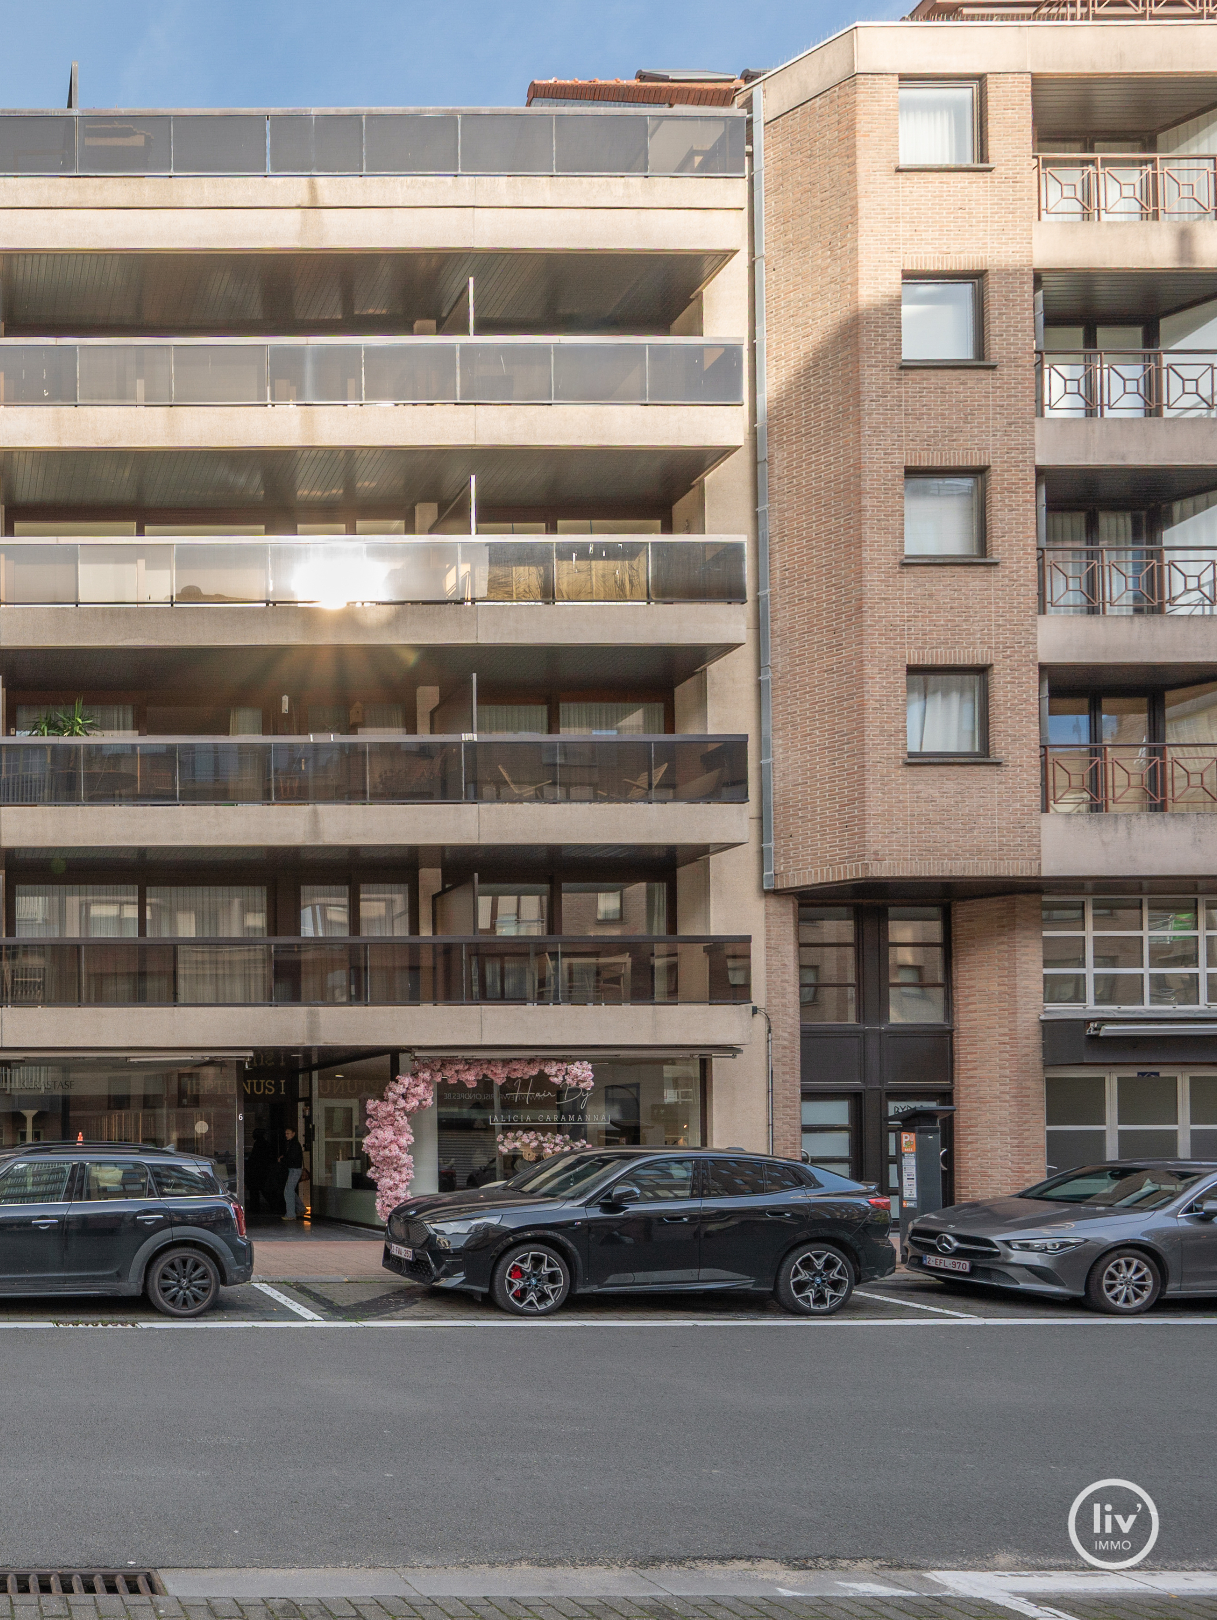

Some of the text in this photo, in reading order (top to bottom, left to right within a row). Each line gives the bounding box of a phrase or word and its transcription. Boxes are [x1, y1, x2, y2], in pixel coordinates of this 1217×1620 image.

[506, 1079, 556, 1105] Hair
[238, 1113, 244, 1121] 6
[493, 1114, 608, 1123] ALICIA CARAMANNA
[926, 1256, 968, 1271] 2-EFL-970
